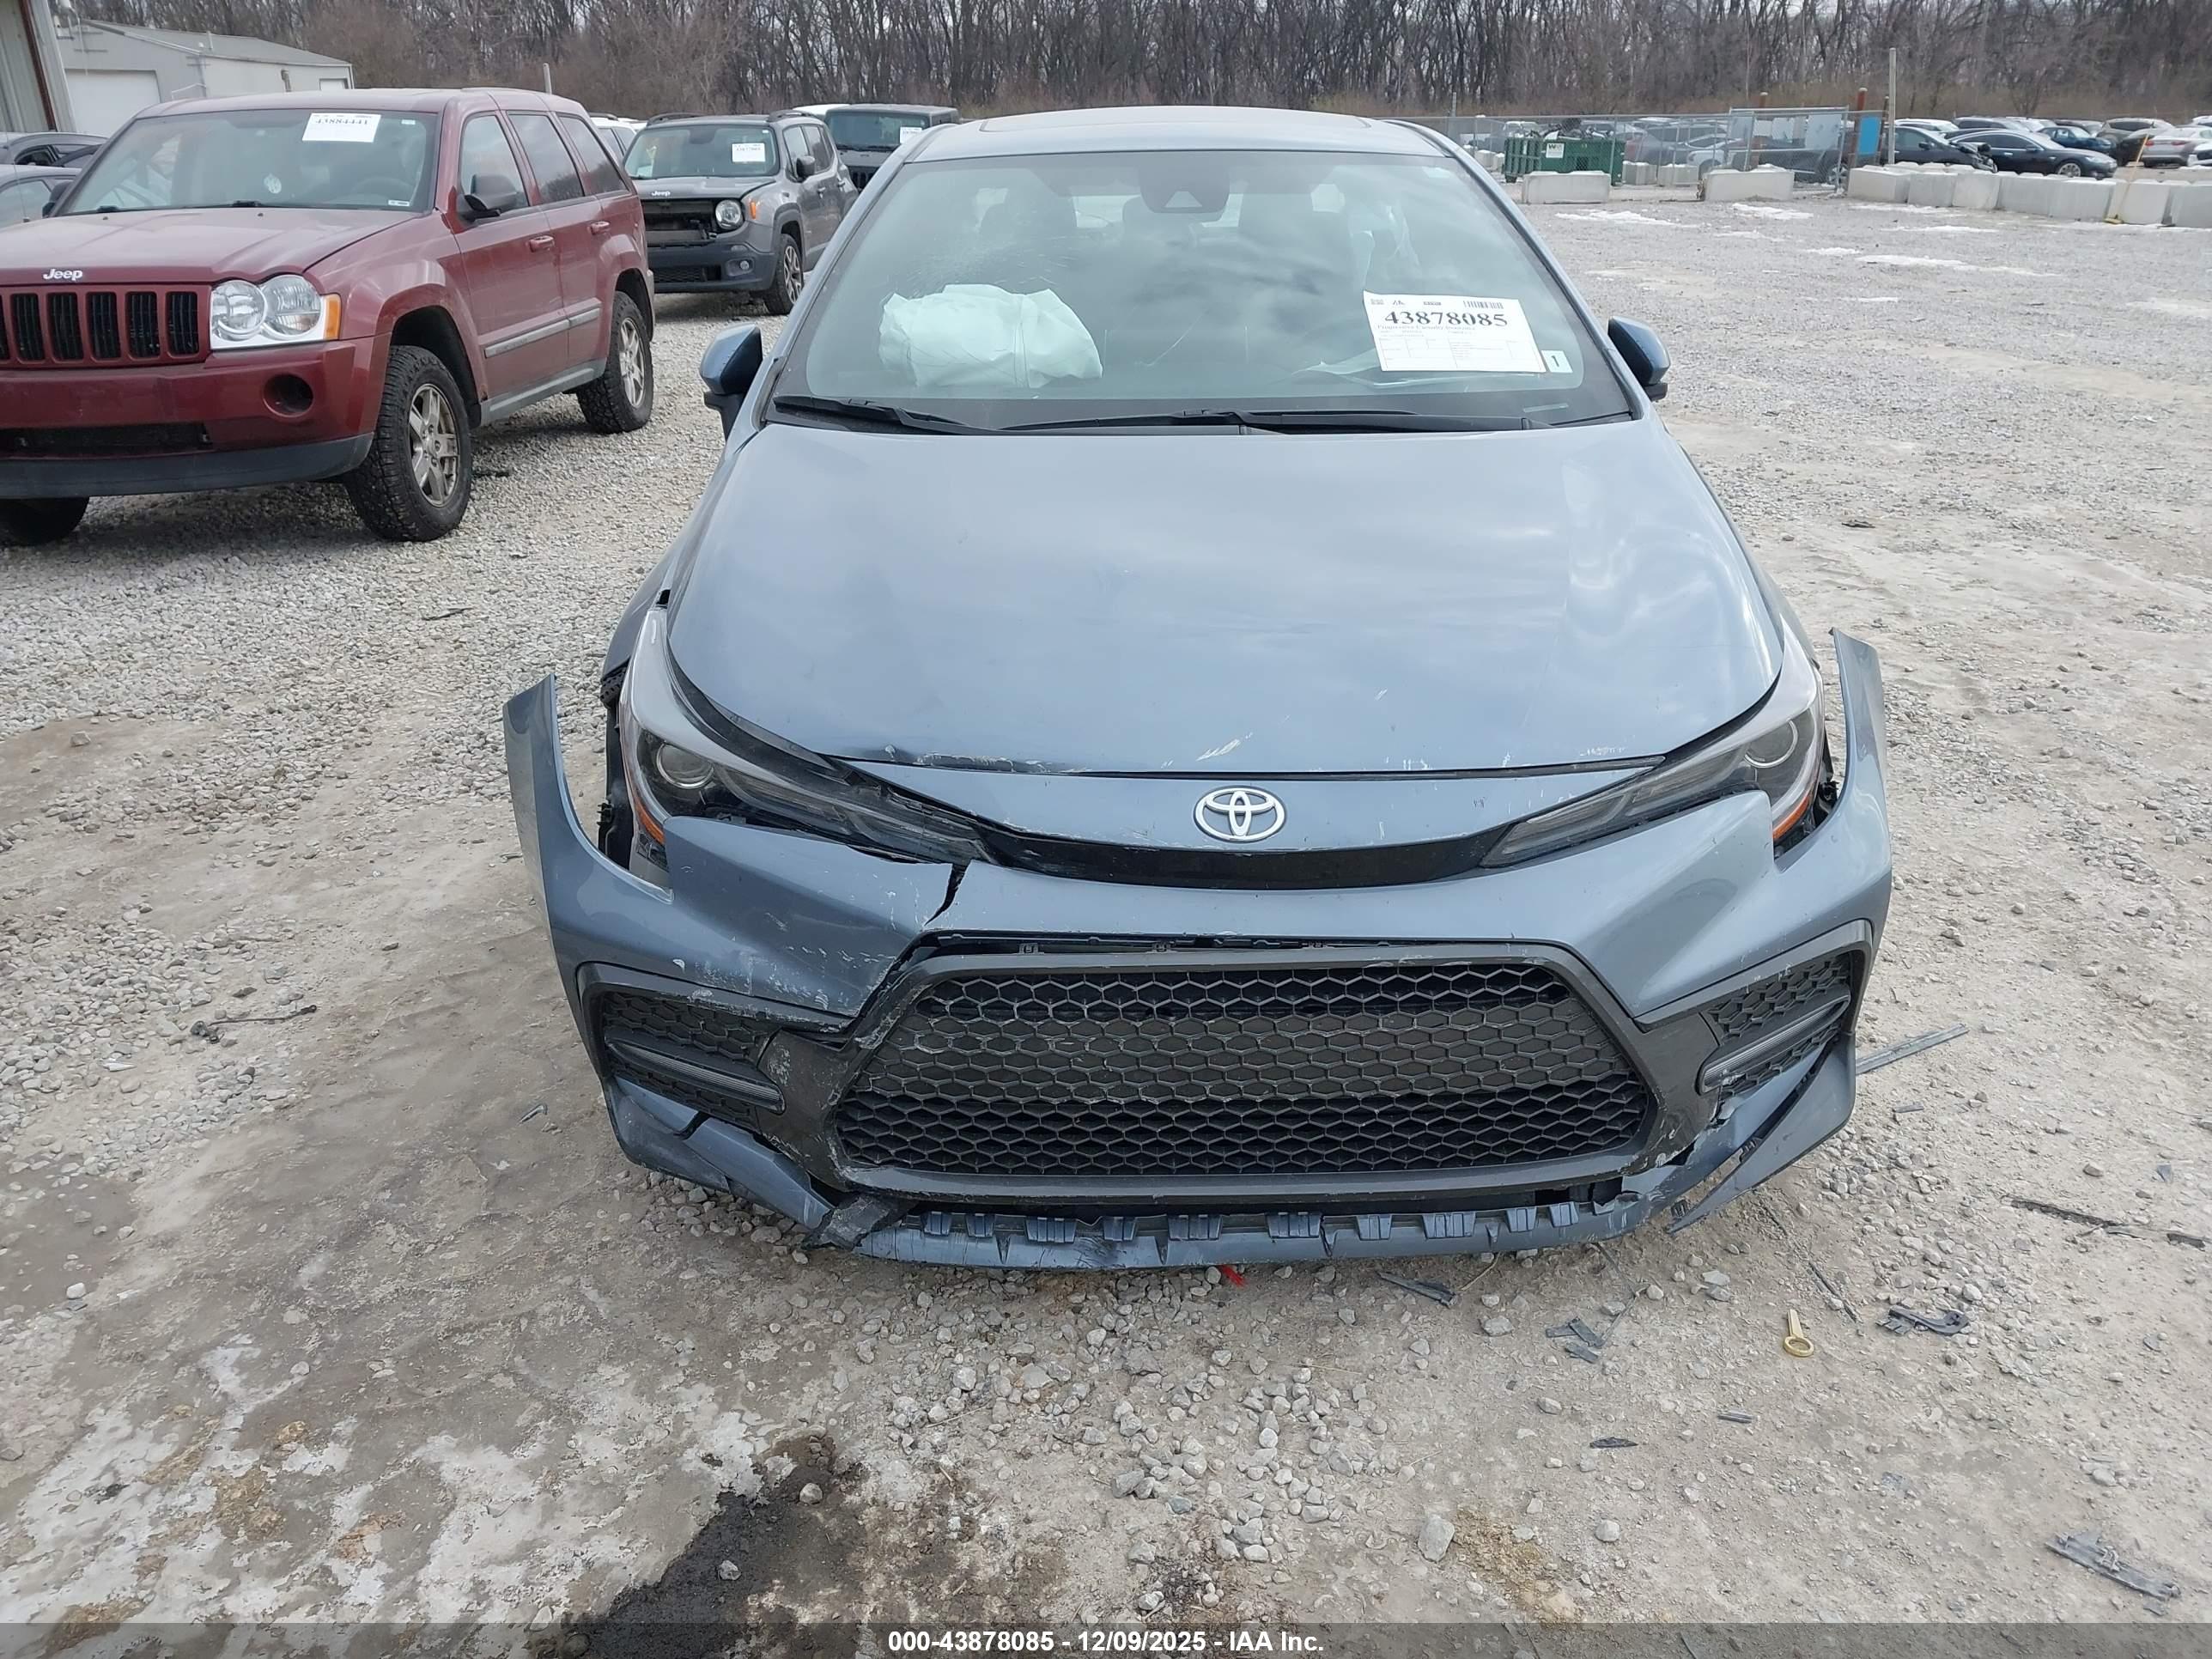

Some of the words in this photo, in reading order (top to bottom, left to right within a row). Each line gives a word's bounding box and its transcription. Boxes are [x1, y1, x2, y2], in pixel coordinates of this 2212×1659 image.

[43, 269, 83, 282] Jeep
[1385, 311, 1508, 327] 43878085
[1551, 355, 1559, 368] 1
